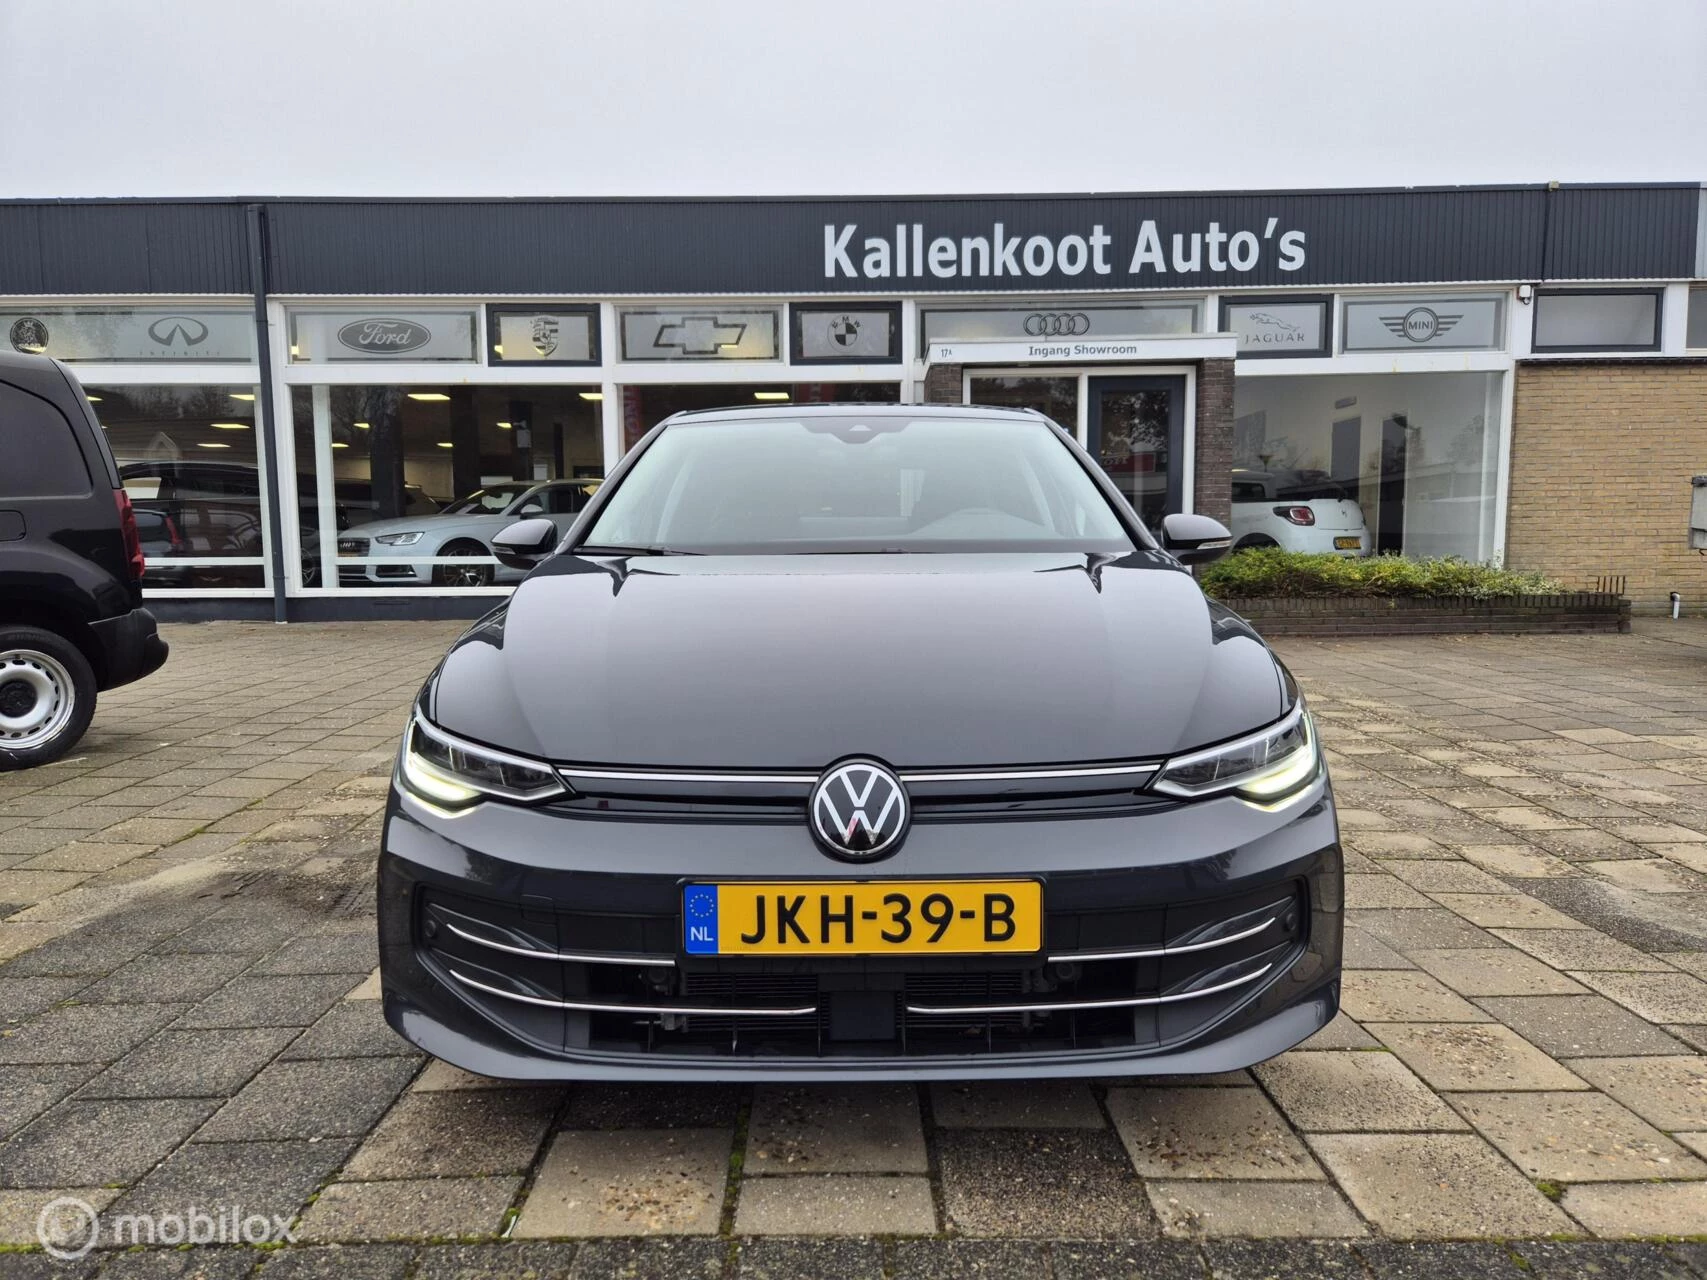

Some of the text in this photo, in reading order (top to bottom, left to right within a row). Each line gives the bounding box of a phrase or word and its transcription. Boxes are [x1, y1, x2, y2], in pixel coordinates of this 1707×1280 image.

[823, 218, 1306, 278] Kallenkoot Auto's
[1408, 320, 1433, 330] MINI
[358, 322, 412, 345] Ford
[1245, 333, 1305, 344] JAGUAR
[1028, 344, 1137, 357] Ingang Showroom
[740, 893, 1016, 944] JKH-39-B
[690, 927, 713, 942] NL
